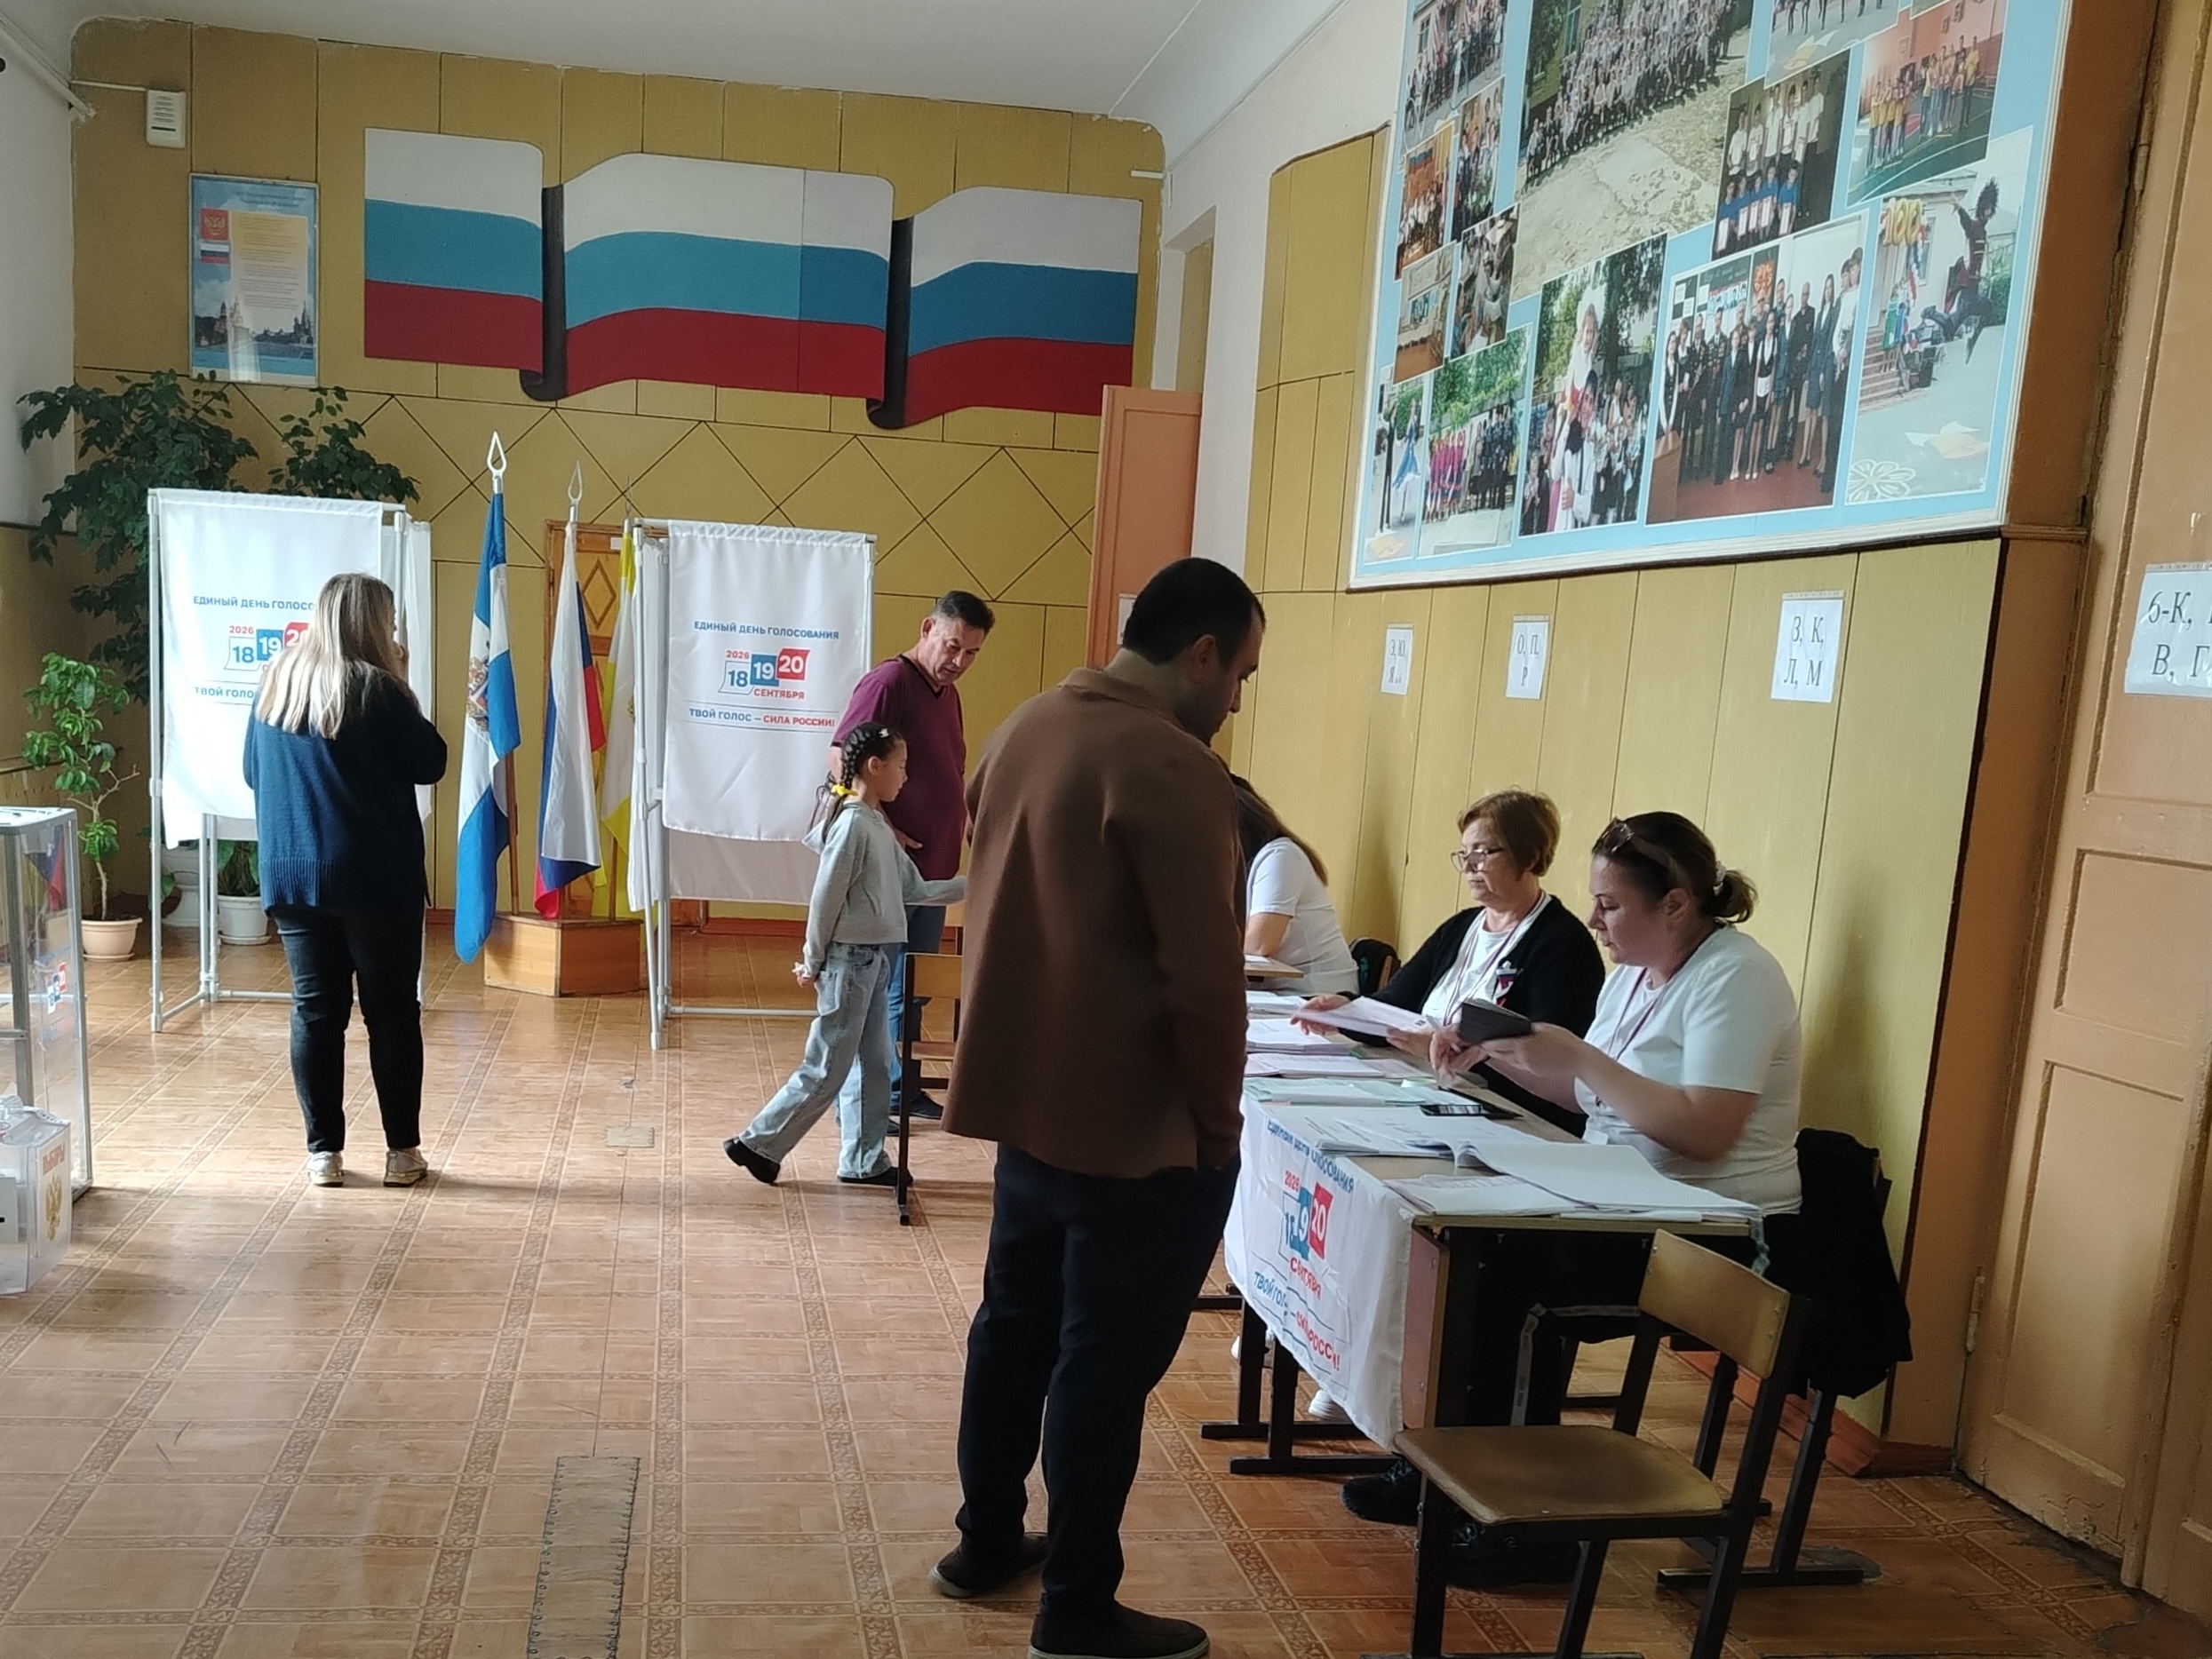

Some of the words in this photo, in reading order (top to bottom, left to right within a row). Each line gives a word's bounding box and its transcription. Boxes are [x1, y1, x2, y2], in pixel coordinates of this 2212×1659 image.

[193, 596, 238, 607] ЕДИНЫЙ
[240, 599, 270, 608] ДЕНЬ
[271, 600, 314, 611] ГОЛОСО
[229, 625, 254, 635] 2026
[694, 621, 736, 632] ЕДИНЫЙ
[738, 624, 766, 635] ДЕНЬ
[768, 627, 839, 639] ГОЛОСОВАНИЯ
[1811, 616, 1824, 649] К,
[233, 646, 254, 663] 18
[259, 637, 282, 655] 19
[726, 650, 750, 659] 2026
[754, 662, 774, 679] 19
[778, 655, 804, 673] 20
[1806, 659, 1823, 687] М
[2151, 644, 2174, 684] В,
[728, 670, 748, 687] 18
[1388, 666, 1395, 684] Я
[1521, 666, 1528, 687] Р
[195, 687, 223, 696] ТВОЙ
[226, 689, 255, 699] ГОЛО
[754, 688, 805, 700] СЕНТЯБРЯ
[689, 708, 716, 718] ТВОЙ
[718, 711, 752, 722] ГОЛОС
[763, 715, 790, 725] СИЛА
[792, 718, 835, 727] РОССИИ!
[1311, 1198, 1326, 1242] 20
[1254, 1271, 1275, 1298] ТВОЙ
